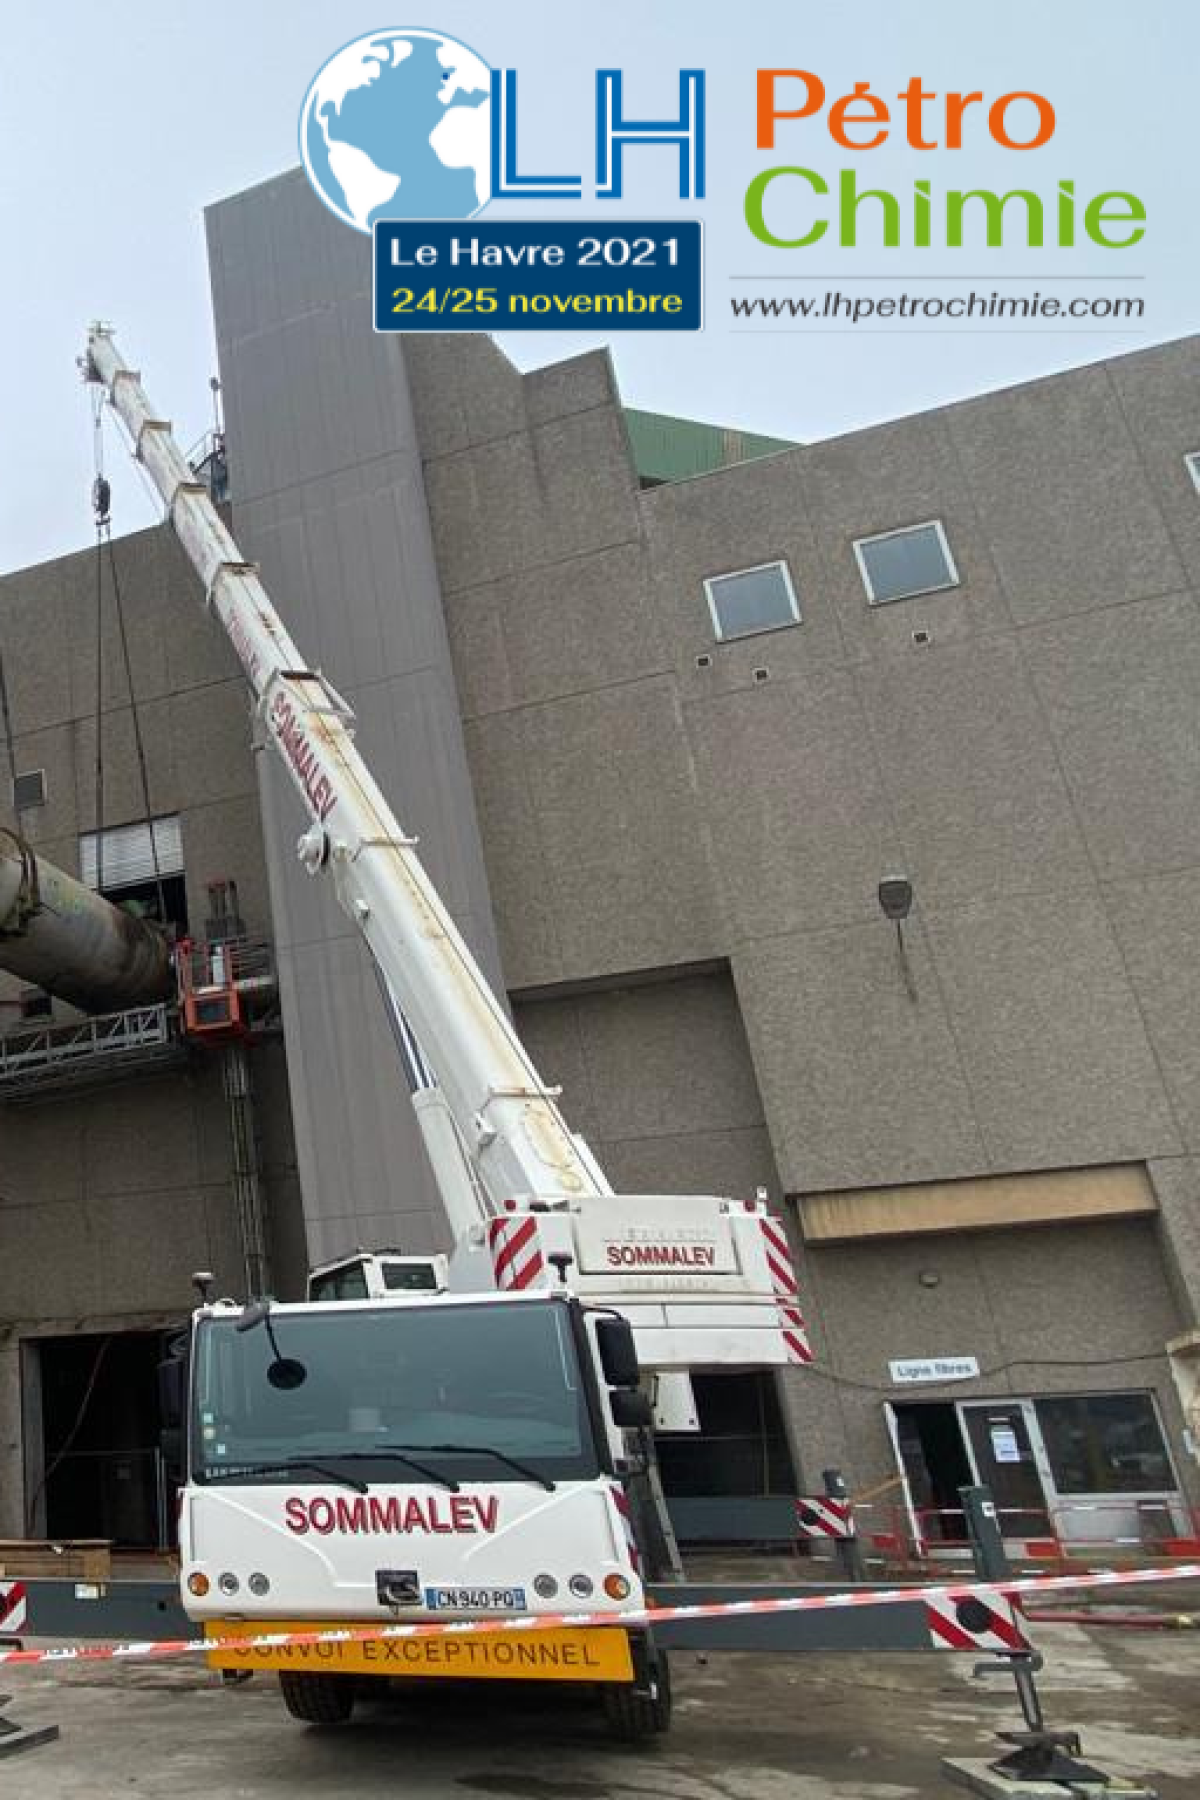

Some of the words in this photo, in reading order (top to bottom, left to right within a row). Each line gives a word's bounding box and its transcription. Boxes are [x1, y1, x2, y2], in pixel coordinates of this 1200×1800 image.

[606, 1245, 715, 1266] SOMMALEV
[284, 1495, 499, 1535] SOMMALEV
[362, 1639, 601, 1666] EXCEPTIONNEL
